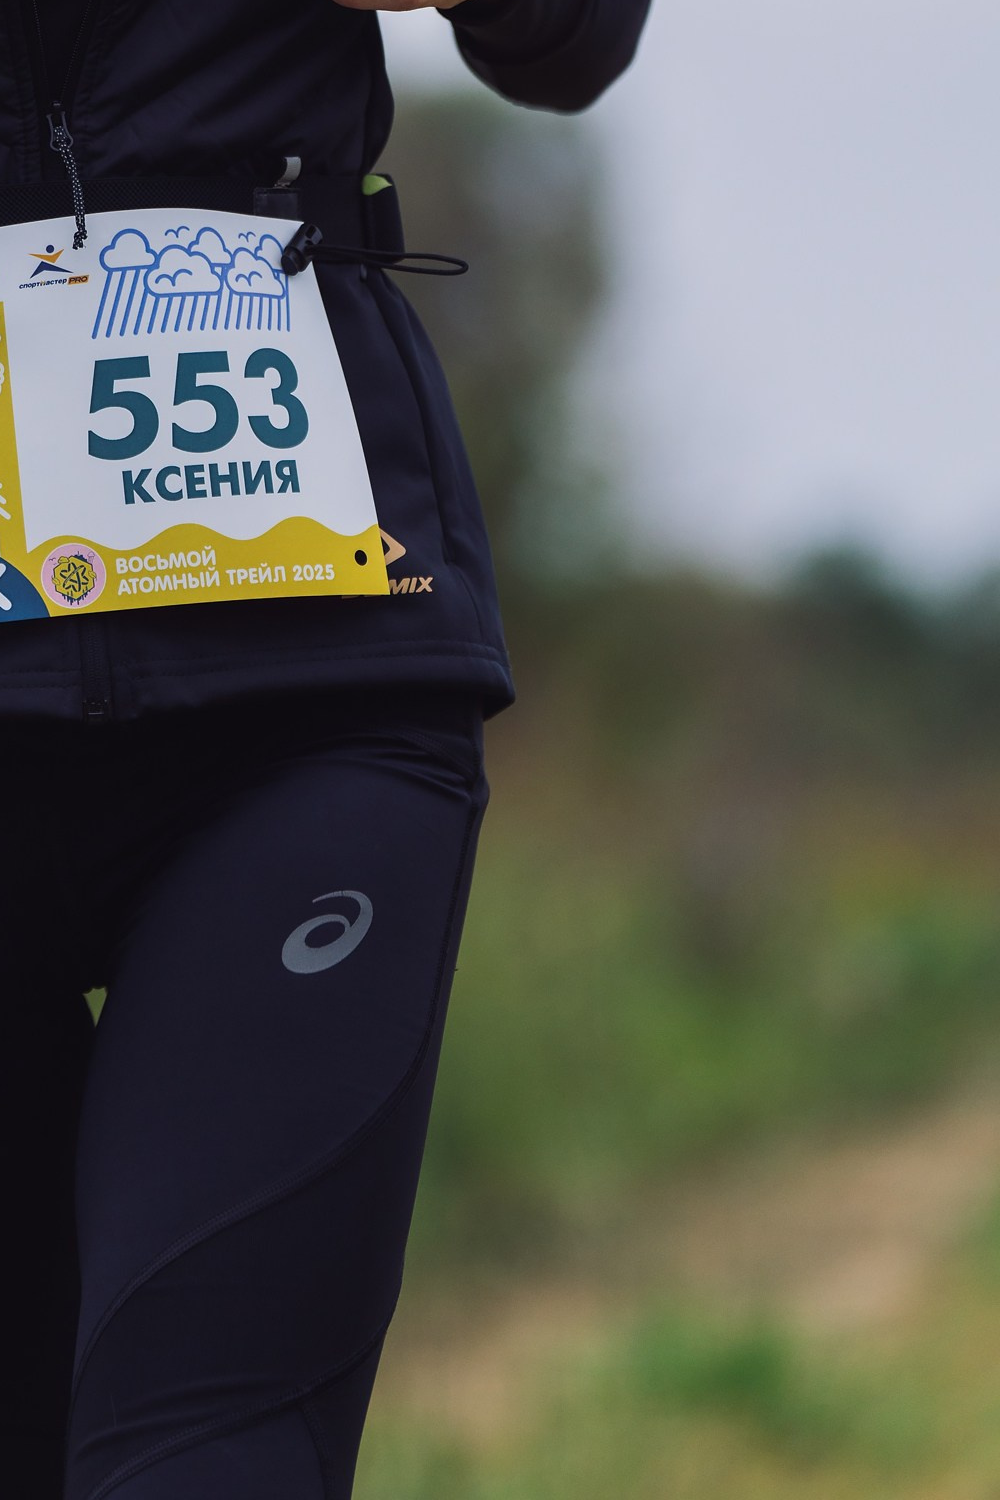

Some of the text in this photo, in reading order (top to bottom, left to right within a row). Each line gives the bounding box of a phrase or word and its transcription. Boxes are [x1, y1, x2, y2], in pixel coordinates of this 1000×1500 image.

[68, 275, 88, 285] PRO
[87, 347, 309, 460] 553
[122, 459, 302, 505] КСЕНИЯ
[115, 546, 217, 575] ВОСЬМОЙ
[117, 562, 335, 596] АТОМНЫЙ ТРЕЙЛ 2025
